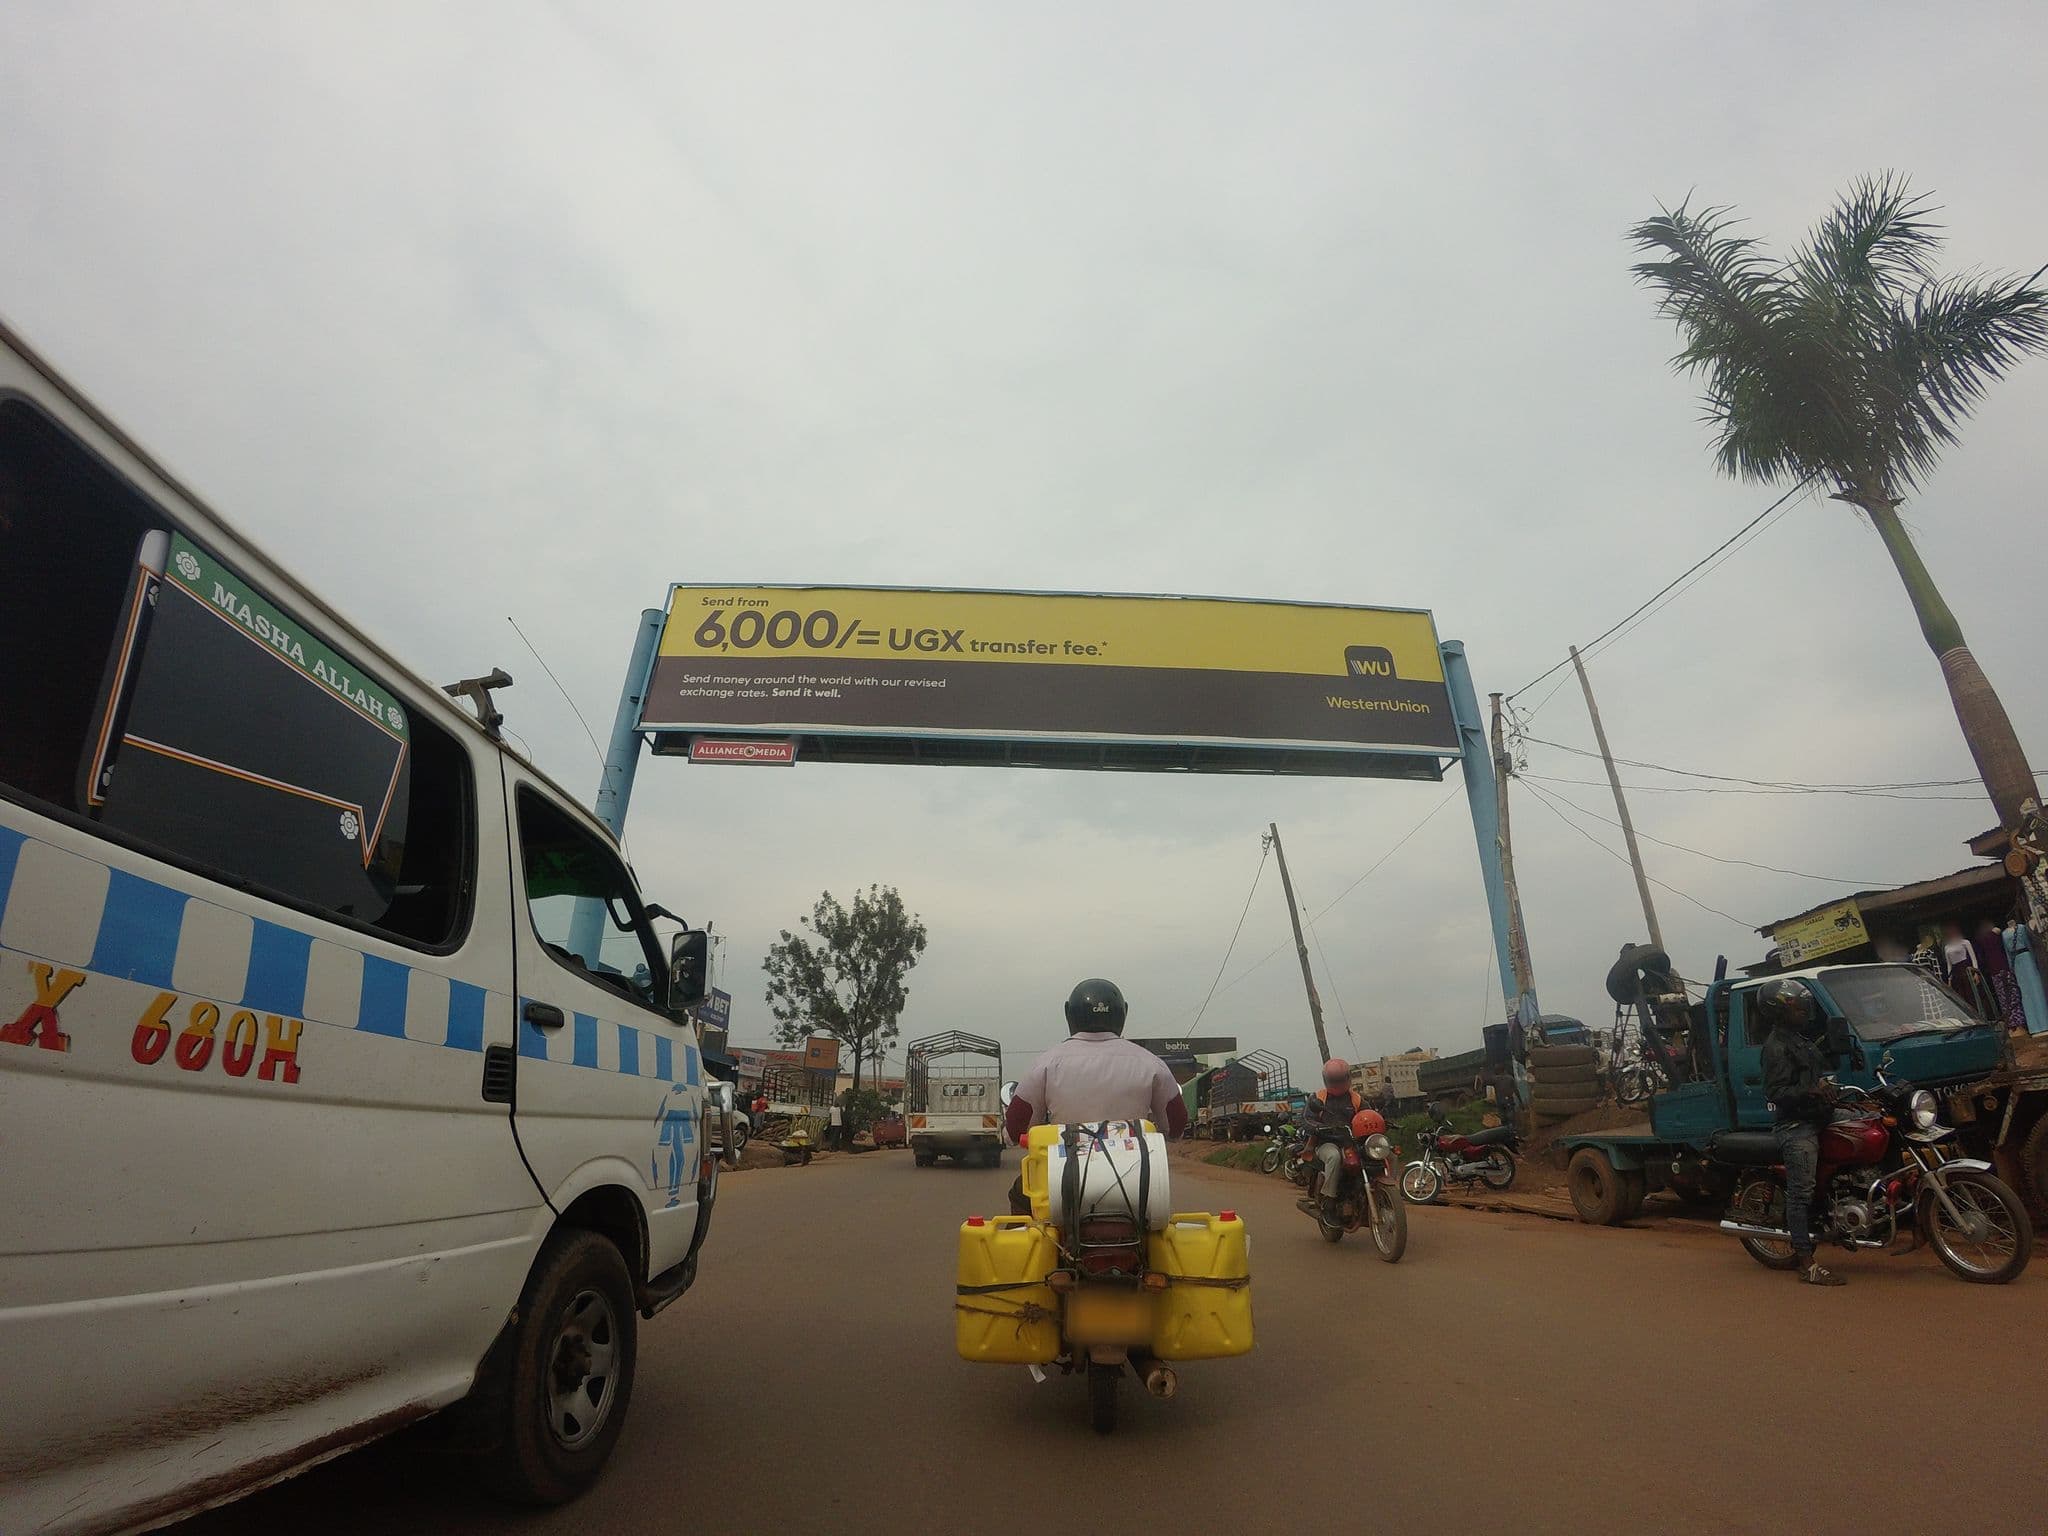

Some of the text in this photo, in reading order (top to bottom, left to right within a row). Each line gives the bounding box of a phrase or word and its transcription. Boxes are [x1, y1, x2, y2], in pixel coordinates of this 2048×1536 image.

[701, 596, 769, 607] Send from
[694, 609, 880, 652] 6,000/=
[888, 628, 965, 653] UGX
[970, 639, 1058, 655] transfer
[211, 581, 384, 721] MASHA ALLAH
[1351, 659, 1391, 676] WU
[683, 674, 946, 688] Send money around the world with our revised
[680, 687, 841, 698] exchange rates. Send it well.
[1325, 696, 1431, 714] WesternUnion
[698, 746, 787, 756] ALLIANCE MEDIA
[714, 996, 729, 1015] BET
[0, 960, 304, 1084] X 680H
